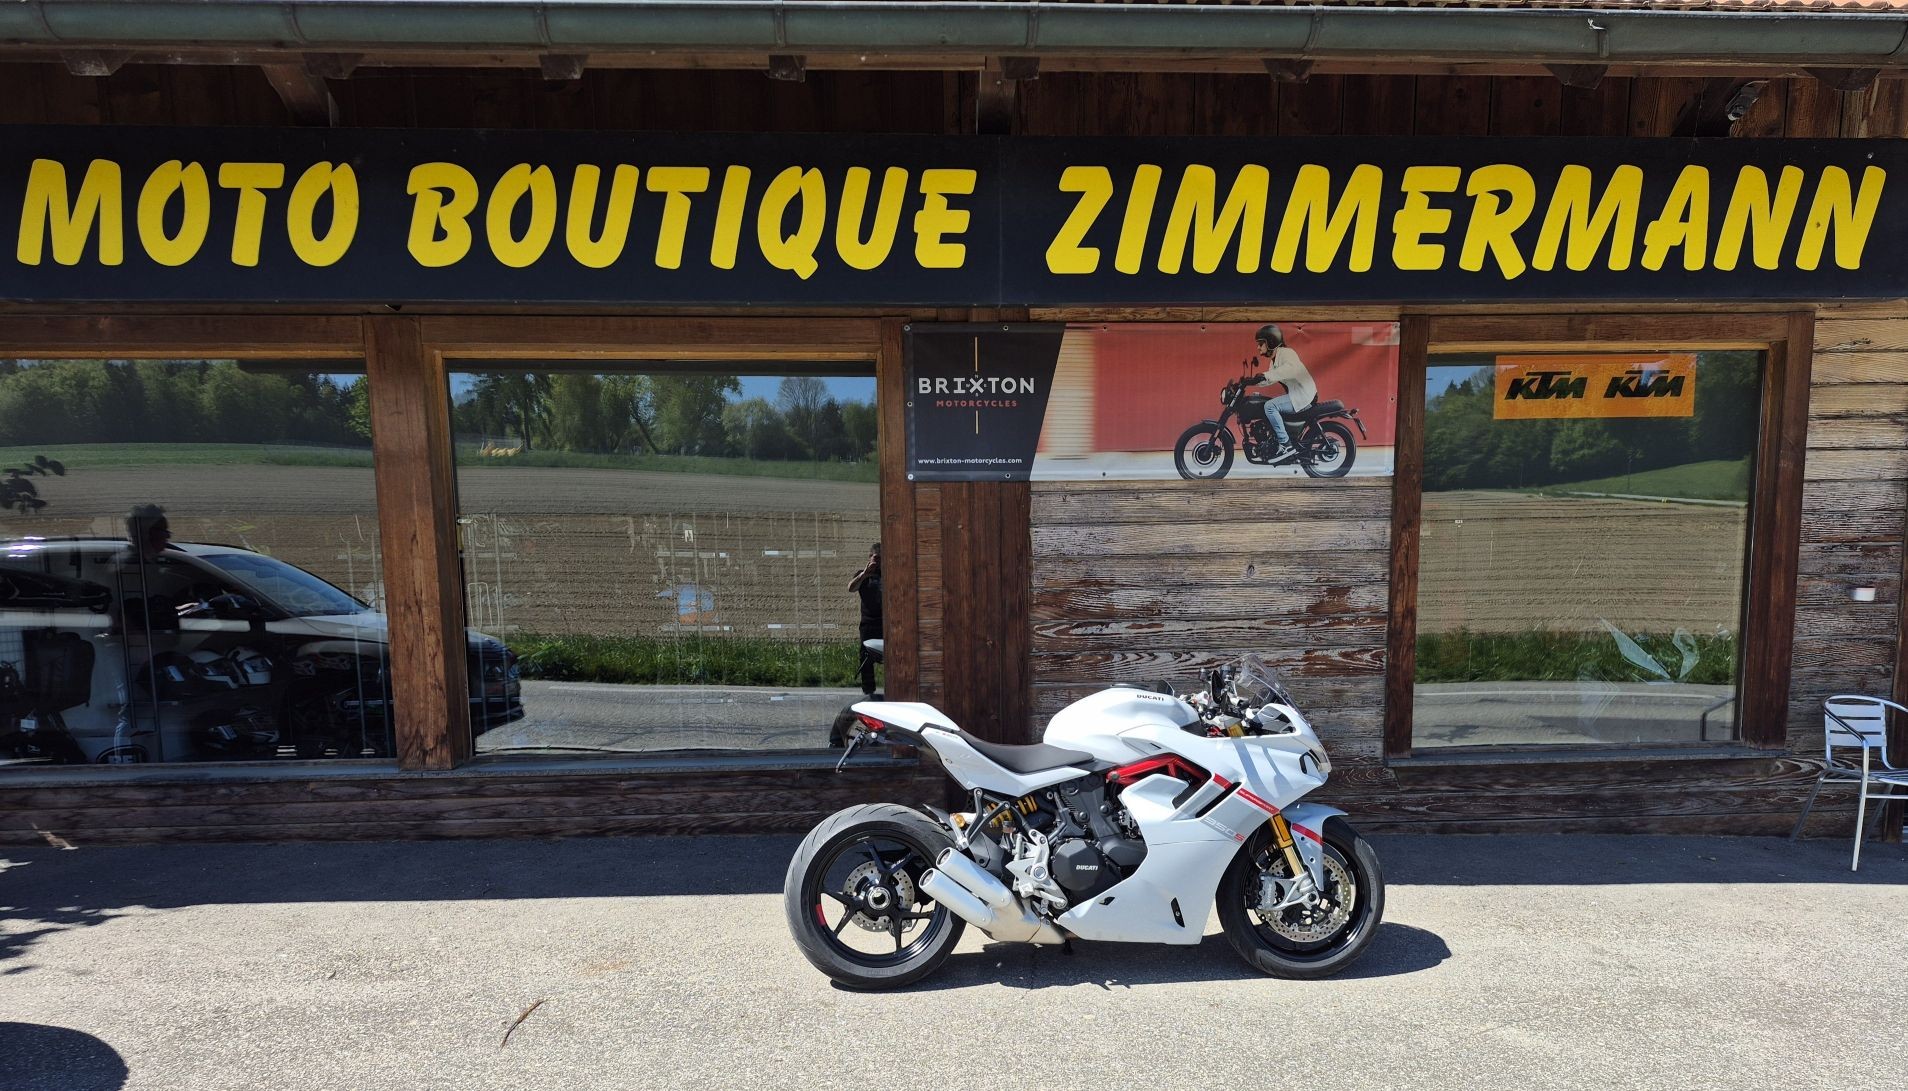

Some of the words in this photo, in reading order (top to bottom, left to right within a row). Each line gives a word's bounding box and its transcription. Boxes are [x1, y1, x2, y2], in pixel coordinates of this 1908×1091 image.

[18, 159, 360, 267] MOTO
[407, 162, 978, 280] BOUTIQUE
[1046, 163, 1888, 280] ZIMMERMANN
[918, 377, 1035, 394] BRIXTON
[1504, 371, 1588, 400] KTM
[1603, 370, 1686, 399] KTM
[936, 400, 1018, 408] MOTORCYCLES
[918, 457, 1022, 466] www.brixton-motorcycles.com
[1136, 694, 1165, 702] DUCATI
